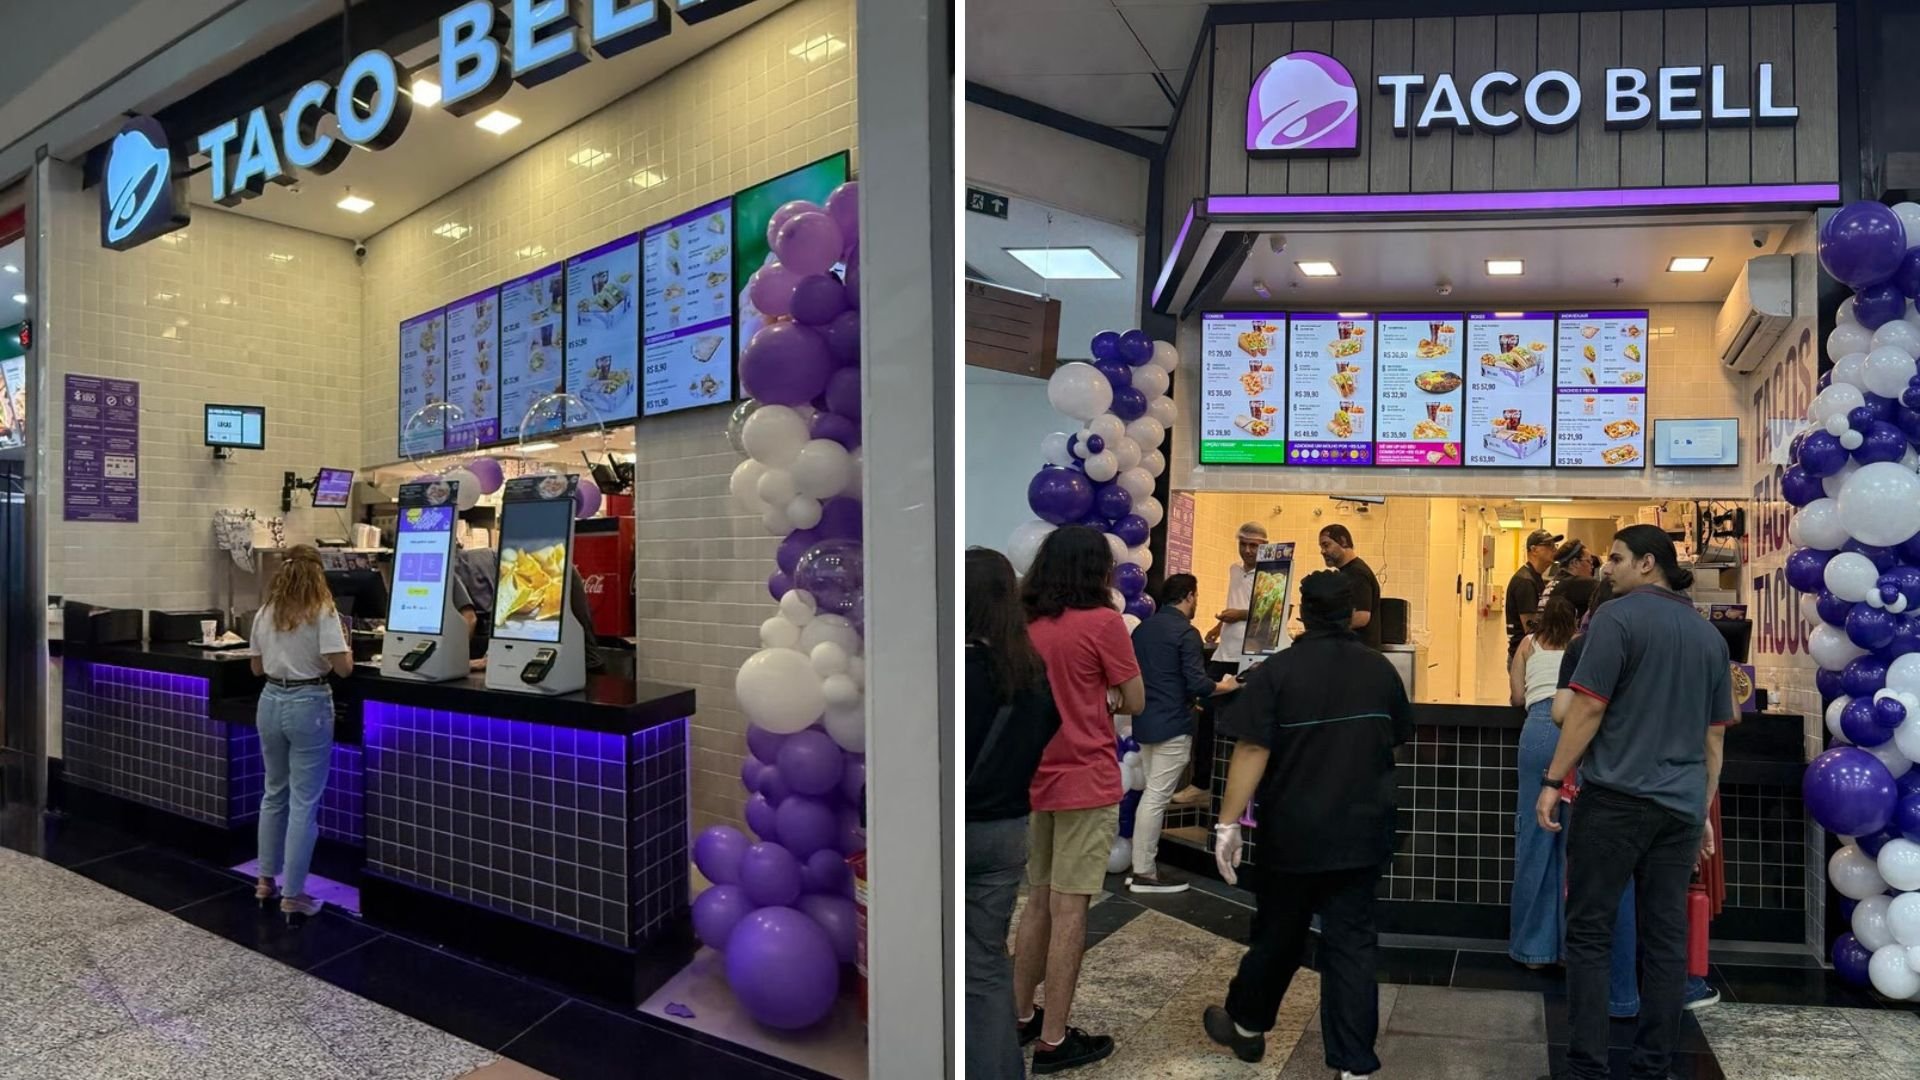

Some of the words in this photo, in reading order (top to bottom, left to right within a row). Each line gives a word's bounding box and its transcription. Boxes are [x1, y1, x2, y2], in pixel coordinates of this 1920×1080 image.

[198, 49, 398, 201] TACO
[440, 0, 706, 106] BEL
[1377, 69, 1581, 129] TACO
[1604, 62, 1799, 123] BELL
[1754, 327, 1811, 464] TACOS
